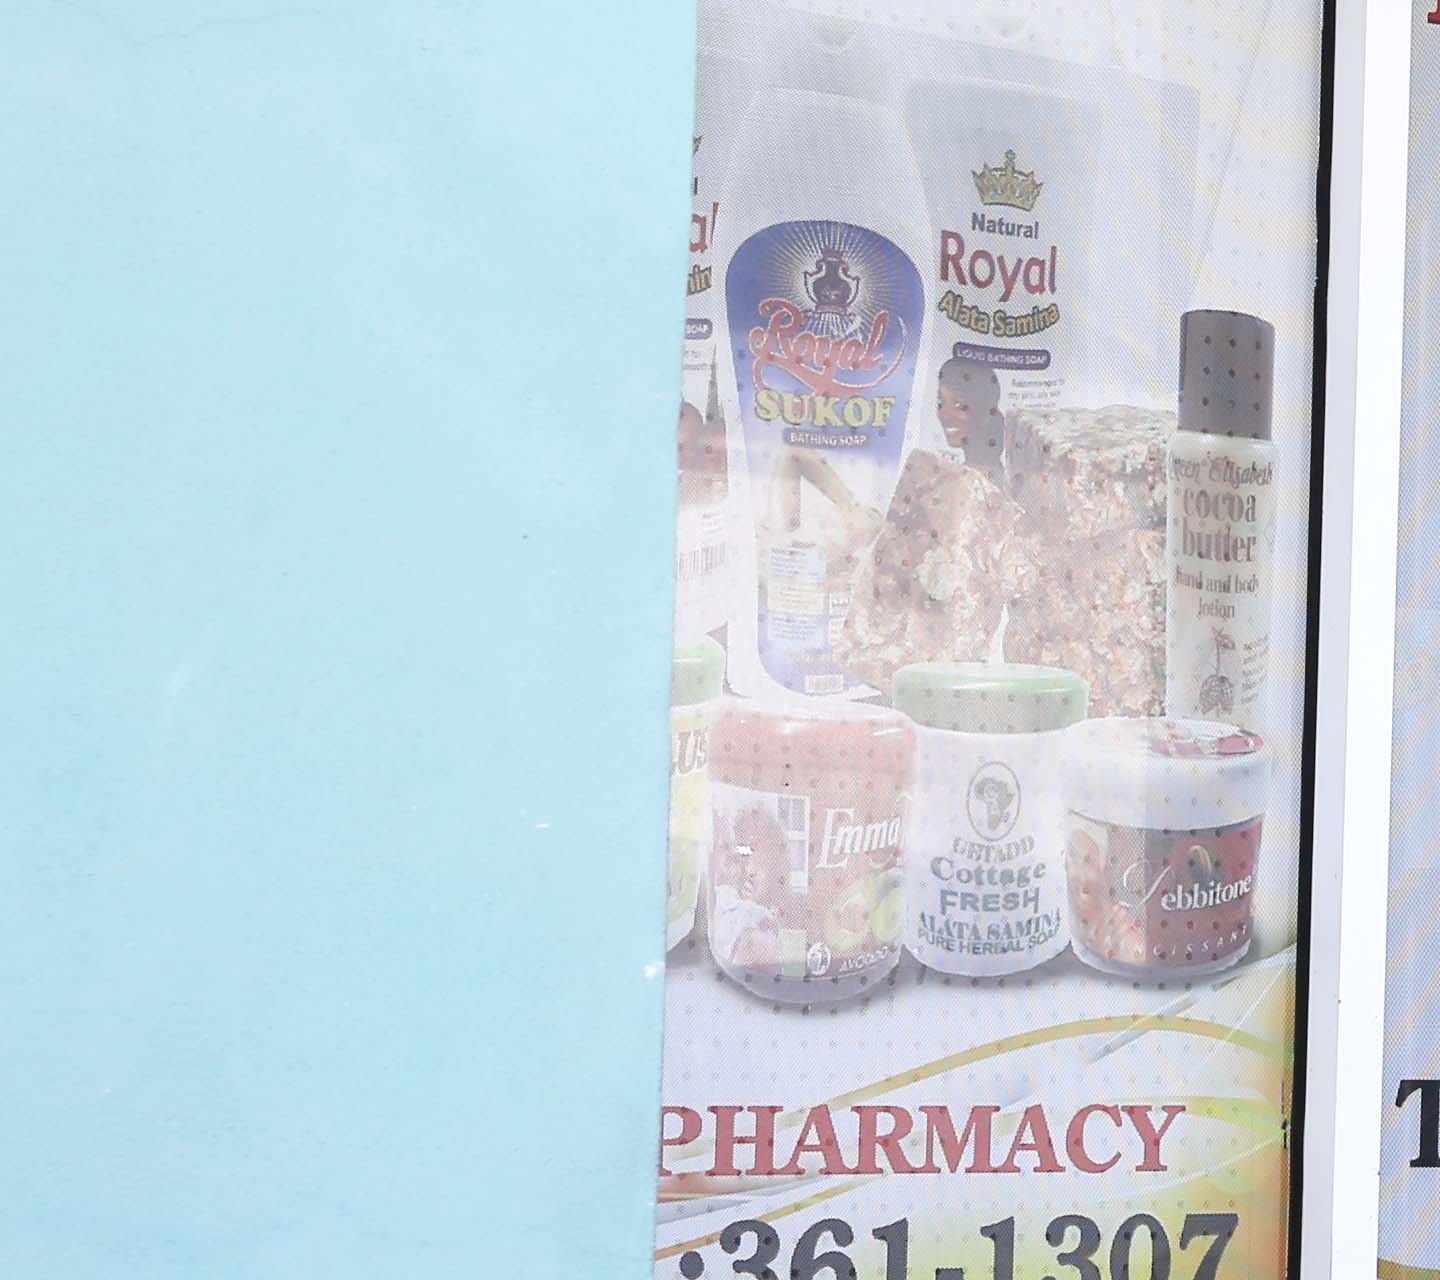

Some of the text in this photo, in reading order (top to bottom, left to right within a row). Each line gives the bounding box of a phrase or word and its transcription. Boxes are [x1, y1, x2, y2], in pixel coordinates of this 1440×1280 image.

[971, 213, 1040, 240] Natural
[940, 229, 1058, 302] Royal
[749, 297, 908, 396] Royal
[1025, 354, 1047, 367] SOAP
[754, 388, 897, 430] SUKOF
[790, 431, 867, 446] BATHING SOAP
[1183, 489, 1257, 523] cocoa
[1182, 518, 1257, 563] butter
[1206, 575, 1232, 594] and
[930, 856, 1047, 888] Cottage
[940, 887, 1040, 916] FRESH
[659, 1103, 1187, 1177] PHARMACY
